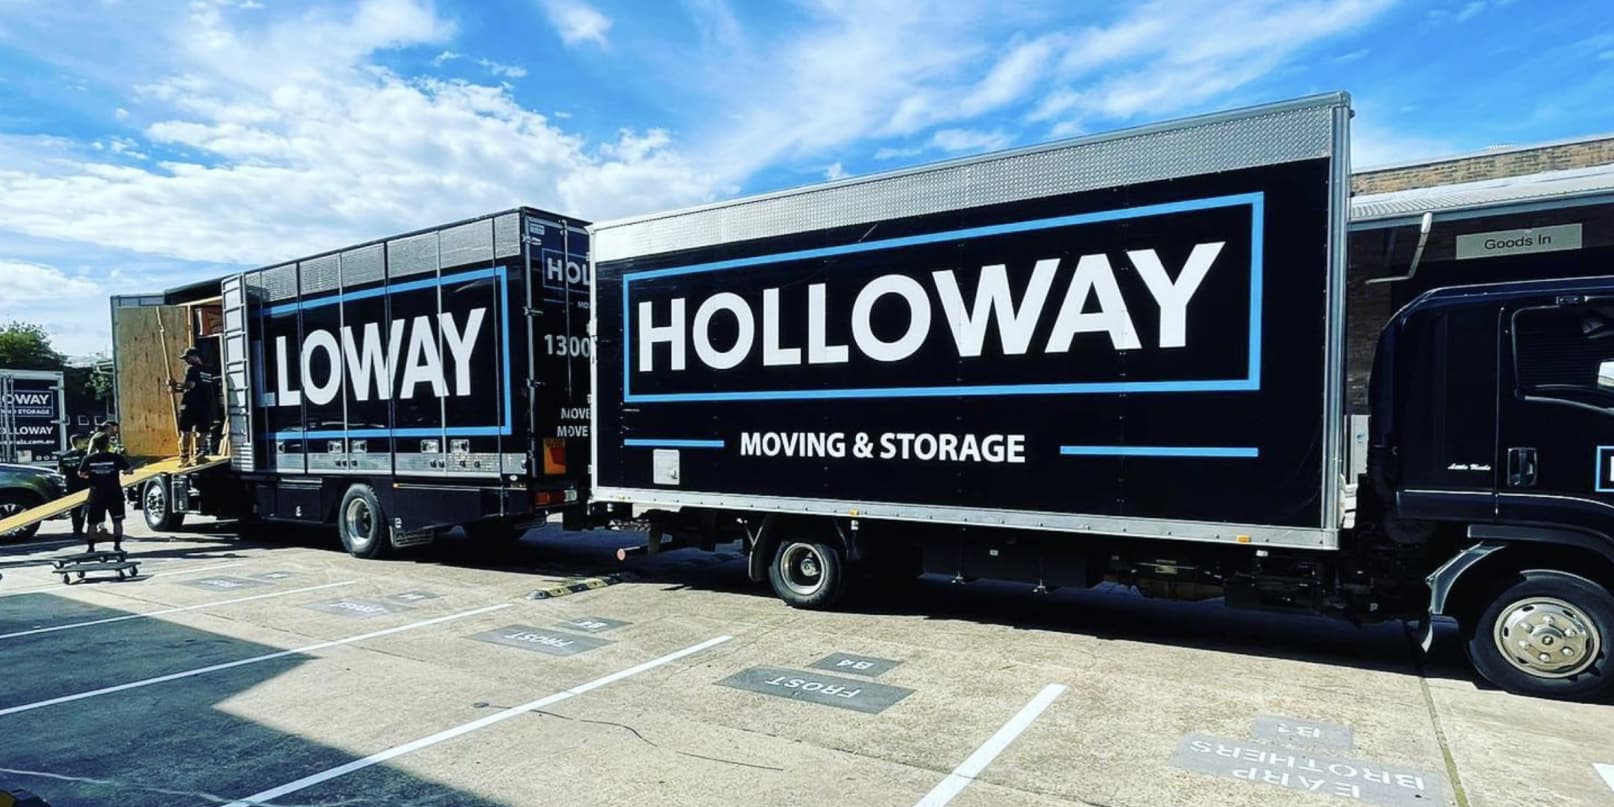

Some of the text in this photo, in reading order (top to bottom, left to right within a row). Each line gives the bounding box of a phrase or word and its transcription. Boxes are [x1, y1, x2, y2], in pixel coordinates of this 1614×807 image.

[1484, 234, 1552, 250] Goods In
[638, 241, 1226, 372] HOLLOWAY
[740, 432, 1025, 463] MOVING & STORAGE
[503, 631, 574, 648] FROST
[836, 659, 875, 670] B4
[765, 676, 861, 698] FROST
[1189, 740, 1425, 790] BROTHERS
[1231, 767, 1361, 798] EARP
